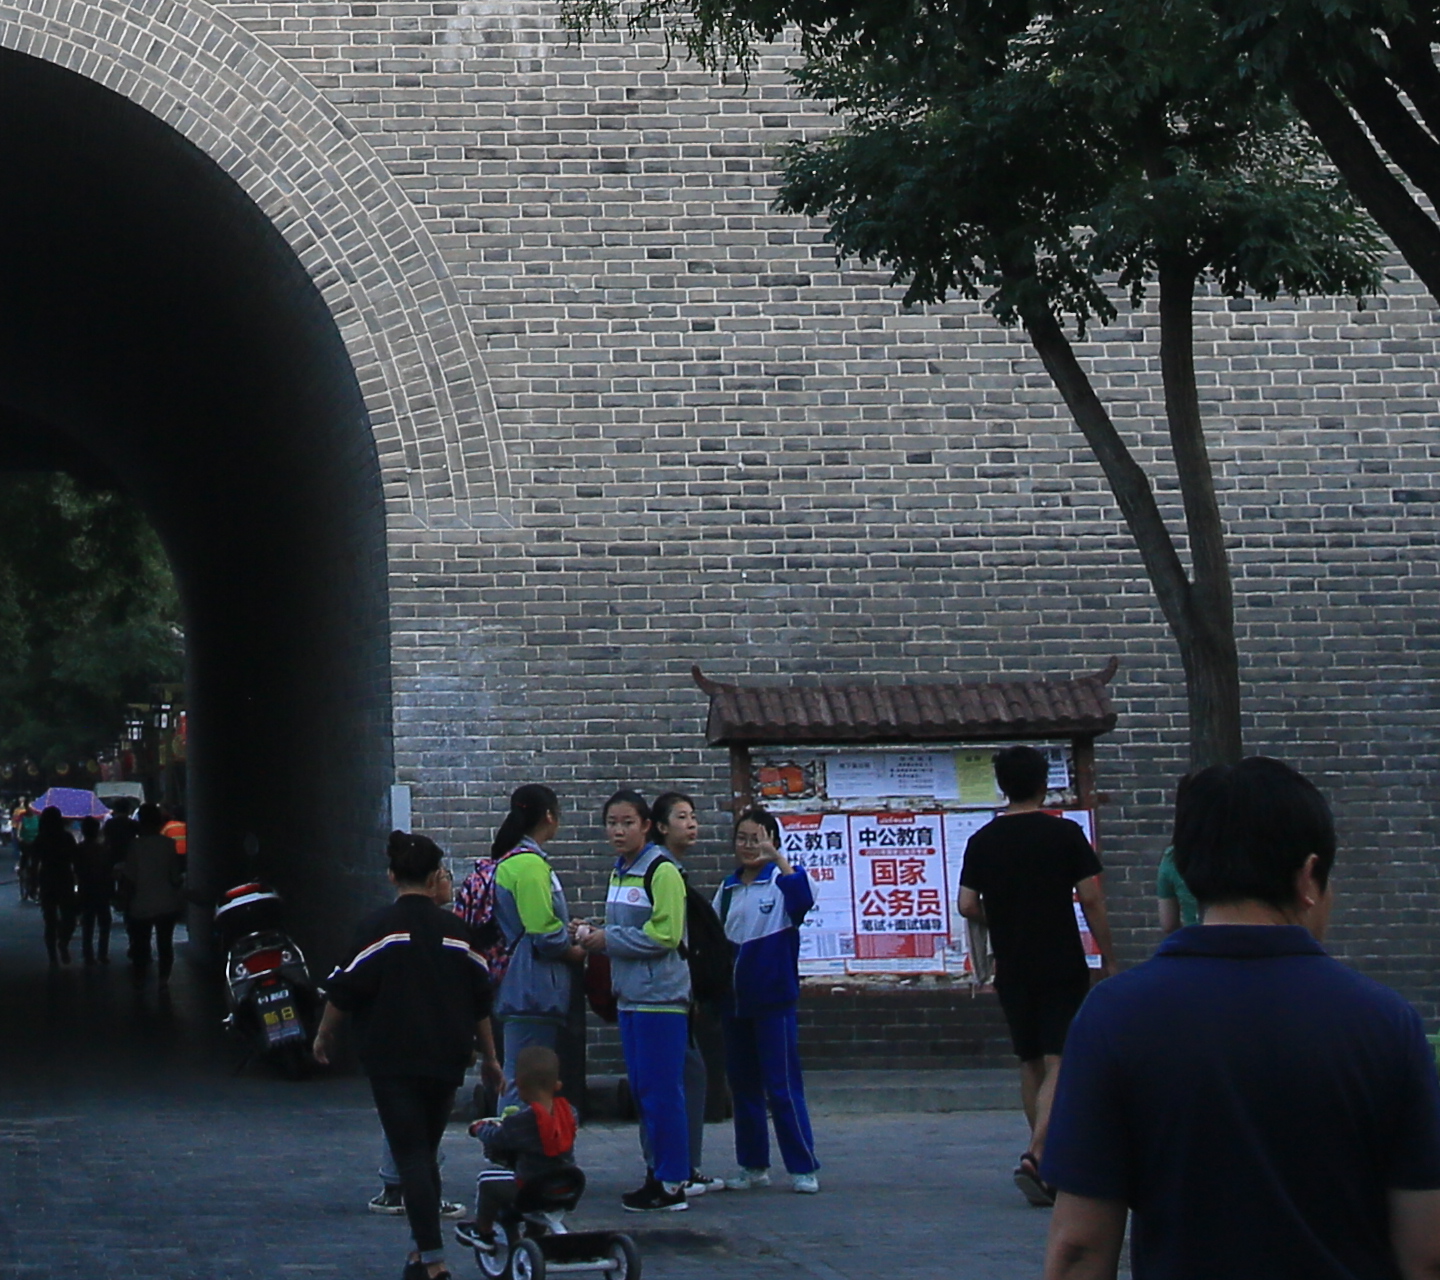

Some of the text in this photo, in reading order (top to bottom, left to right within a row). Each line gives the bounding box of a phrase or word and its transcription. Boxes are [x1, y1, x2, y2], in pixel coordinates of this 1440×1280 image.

[784, 831, 843, 852] 公教育
[859, 826, 934, 847] 中公教育
[871, 857, 927, 887] 国家
[859, 889, 942, 917] 公务员
[861, 919, 943, 932] 笔试+面试辅导
